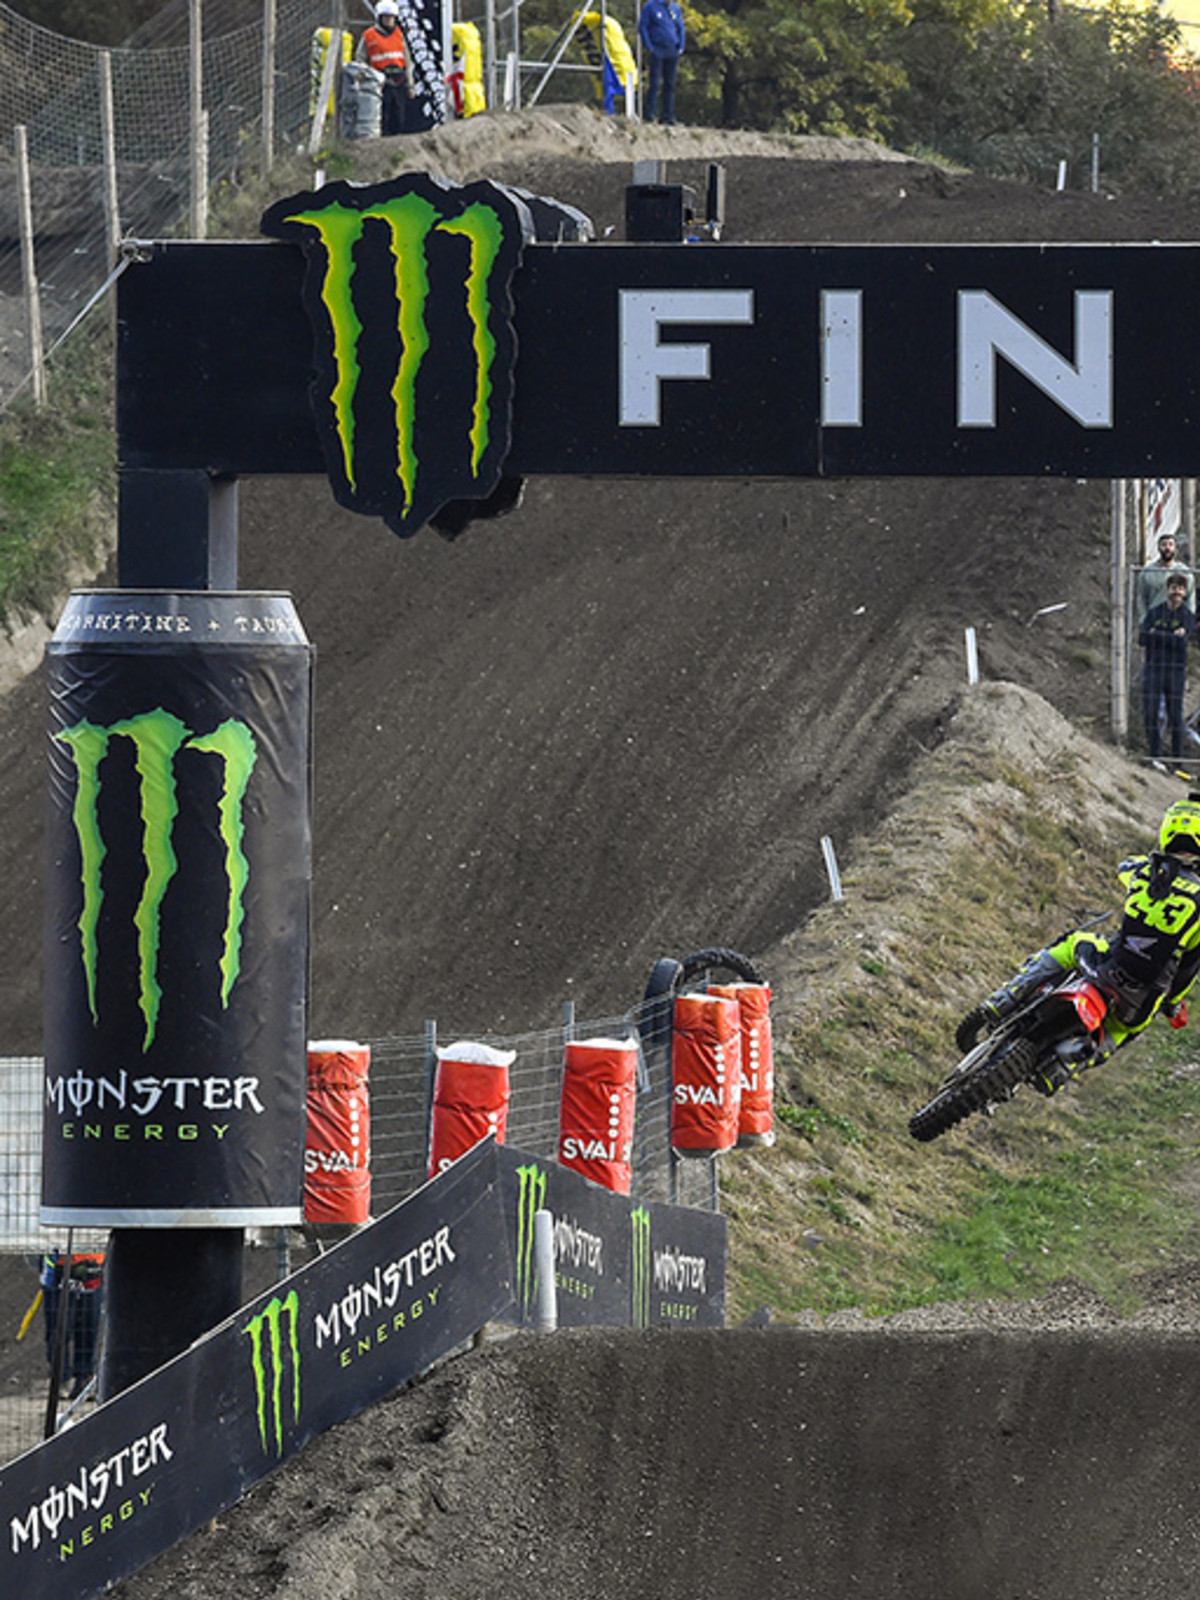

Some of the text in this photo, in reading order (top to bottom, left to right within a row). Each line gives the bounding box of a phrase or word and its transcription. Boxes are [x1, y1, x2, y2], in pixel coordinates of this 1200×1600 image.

[1125, 878, 1197, 935] 243
[46, 1068, 266, 1117] MONSTER
[674, 1084, 724, 1106] SVAI
[62, 1123, 230, 1140] ENERGY
[562, 1138, 616, 1161] SVAI
[304, 1150, 358, 1173] SVAI
[314, 1225, 456, 1349] MONSTER
[340, 1286, 440, 1368] ENERGY
[660, 1302, 699, 1321] ENERGY
[10, 1422, 174, 1554] MONSTER
